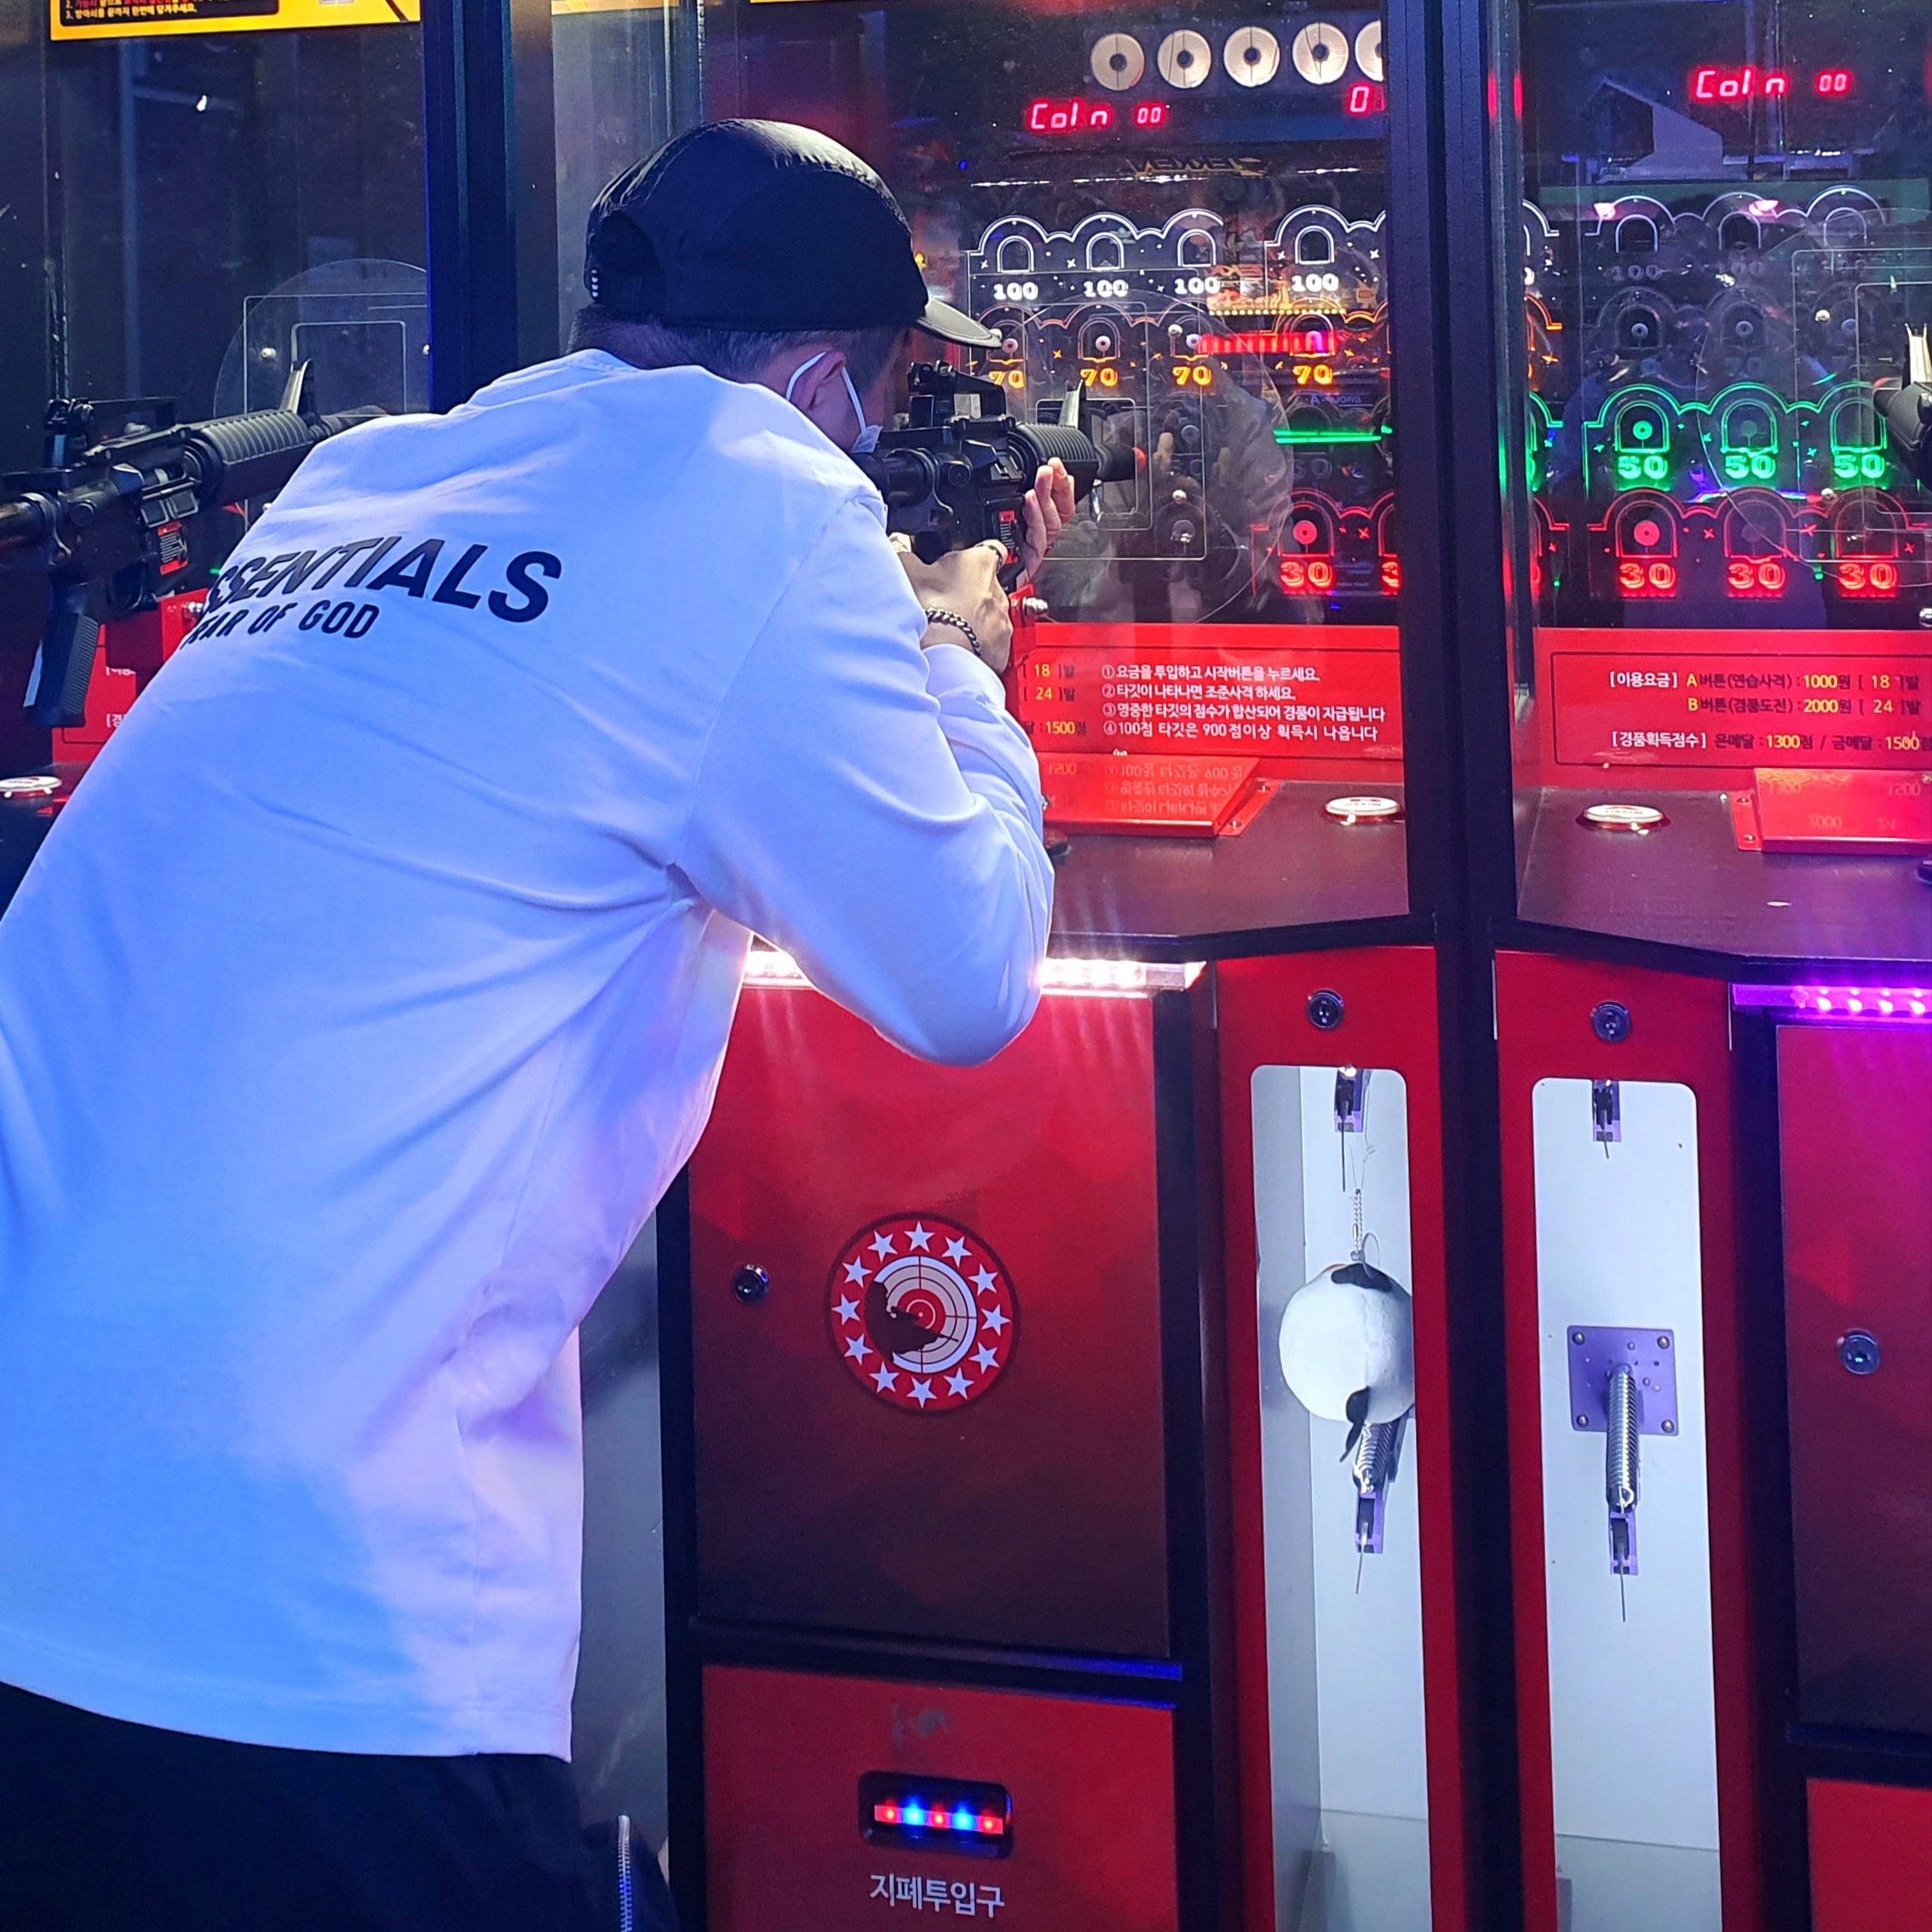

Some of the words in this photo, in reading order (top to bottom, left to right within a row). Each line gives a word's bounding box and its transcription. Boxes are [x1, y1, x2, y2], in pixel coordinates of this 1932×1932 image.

[1818, 74, 1848, 92] 00
[1137, 106, 1162, 124] 00
[993, 282, 1038, 301] 100
[1083, 279, 1128, 297] 100
[1174, 277, 1219, 295] 100
[1291, 273, 1338, 292] 100
[988, 369, 1025, 388] 70
[1079, 368, 1118, 386] 70
[1172, 366, 1211, 385] 70
[1293, 365, 1333, 384] 70
[1619, 454, 1669, 479] 50
[1724, 454, 1776, 479] 50
[1833, 453, 1885, 478] 50
[198, 536, 562, 623] SSENTIALS
[1279, 561, 1333, 588] 30
[1619, 563, 1676, 589] 30
[1728, 563, 1785, 589] 30
[1838, 563, 1897, 589] 30
[247, 601, 298, 635] OF
[298, 599, 380, 639] GOD
[1034, 664, 1050, 677] 18
[1154, 665, 1203, 681] 투입하고
[1205, 665, 1265, 681] 시작버튼을
[1267, 666, 1320, 682] 누르세요.
[1872, 675, 1890, 688] 18
[1036, 687, 1052, 700] 24
[1155, 684, 1203, 699] 나타나면
[1205, 685, 1253, 700] 조준사격
[1155, 703, 1192, 719] 타깃의
[1193, 704, 1230, 719] 점수가
[1232, 704, 1280, 720] 합산되어
[1283, 705, 1320, 721] 경품이
[1322, 706, 1386, 722] 지급됩니다
[1873, 699, 1893, 713] 24
[1159, 722, 1199, 739] 타깃은
[1277, 724, 1318, 740] 획득시
[1323, 725, 1378, 742] 나옵니다
[870, 1873, 1005, 1918] 지폐투입구
